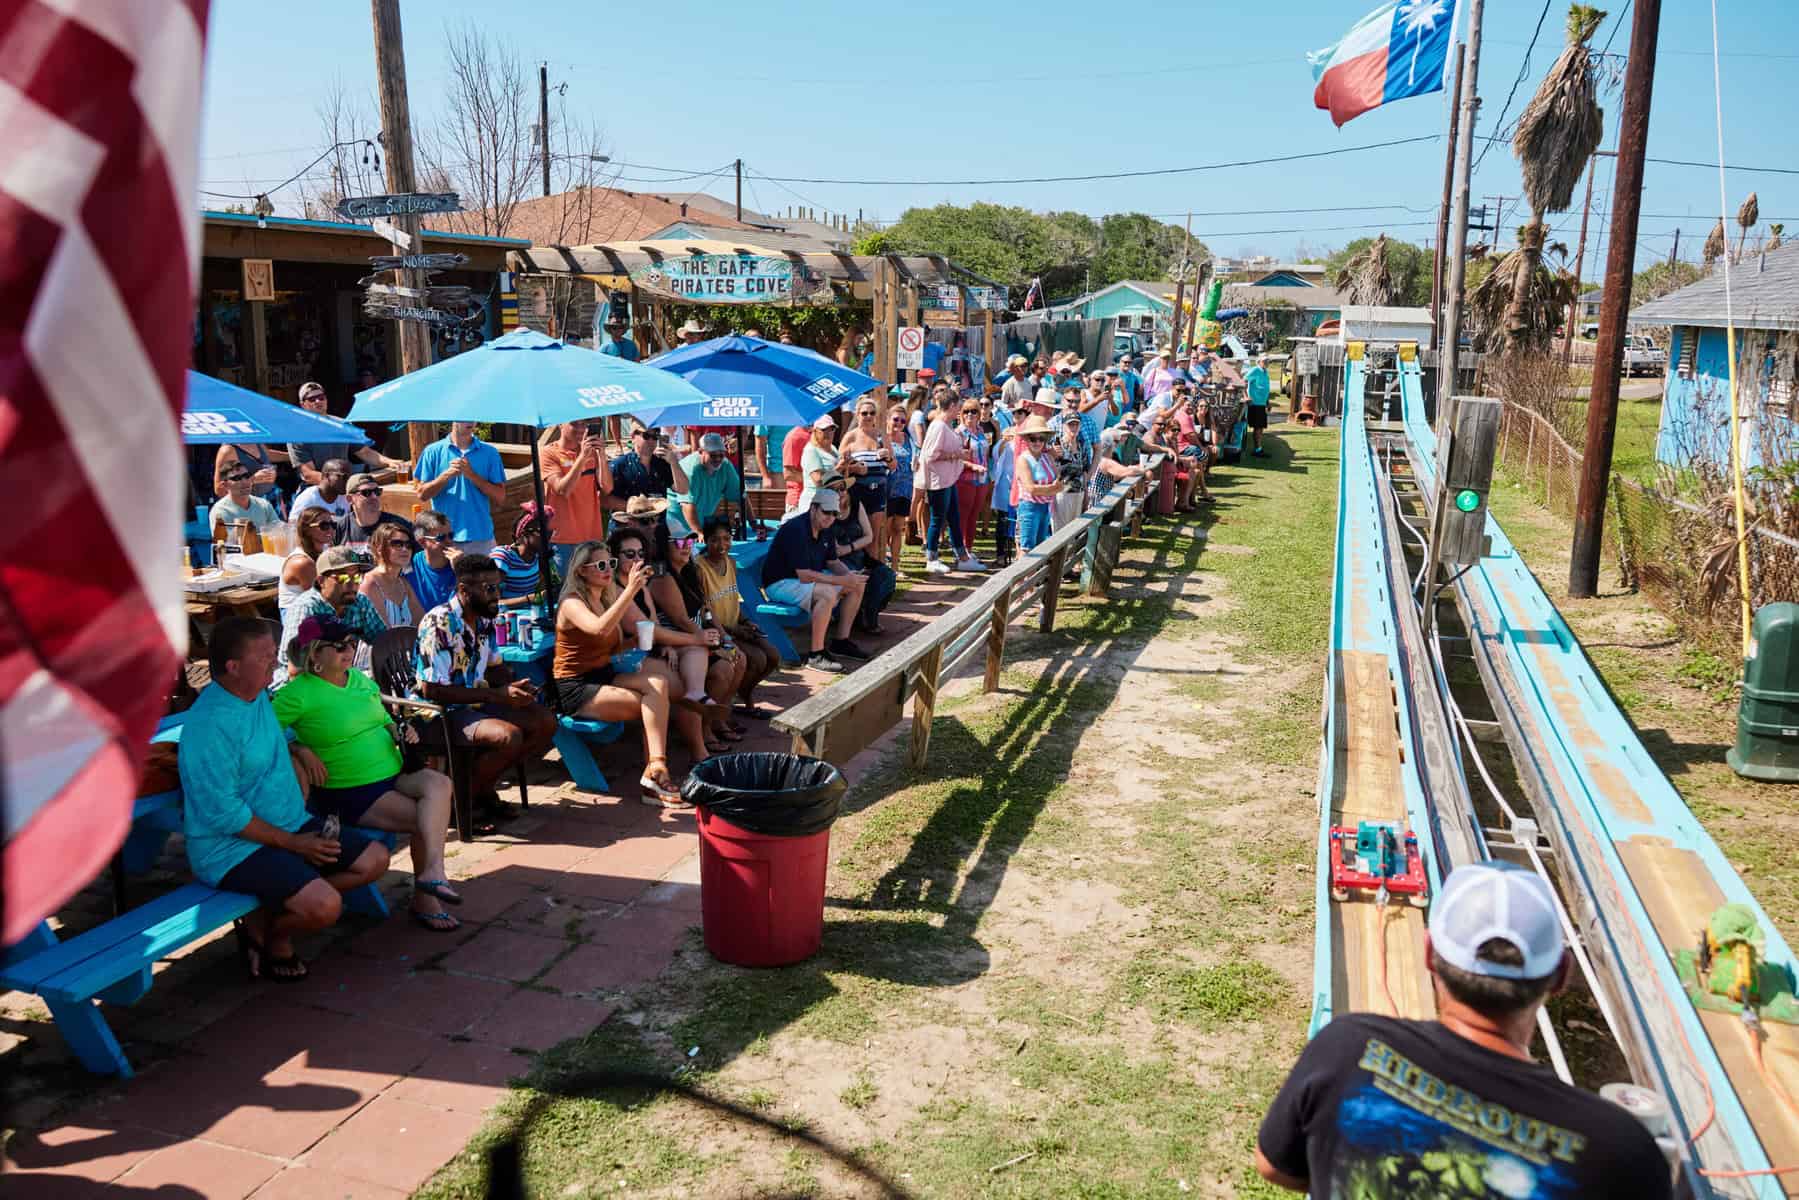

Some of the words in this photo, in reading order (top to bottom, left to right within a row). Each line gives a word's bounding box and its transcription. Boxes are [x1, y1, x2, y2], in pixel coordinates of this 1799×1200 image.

[682, 261, 709, 275] THE
[719, 260, 758, 275] GAFF
[671, 278, 735, 294] PIRATES
[745, 278, 788, 293] COVE
[576, 384, 627, 398] BUD
[806, 376, 834, 395] BUD
[577, 391, 646, 409] LIGHT
[814, 383, 850, 404] LIGHT
[711, 397, 752, 407] BUD
[703, 406, 759, 418] LIGHT
[181, 422, 252, 434] GHT
[1358, 1038, 1587, 1164] HIDEOUT
